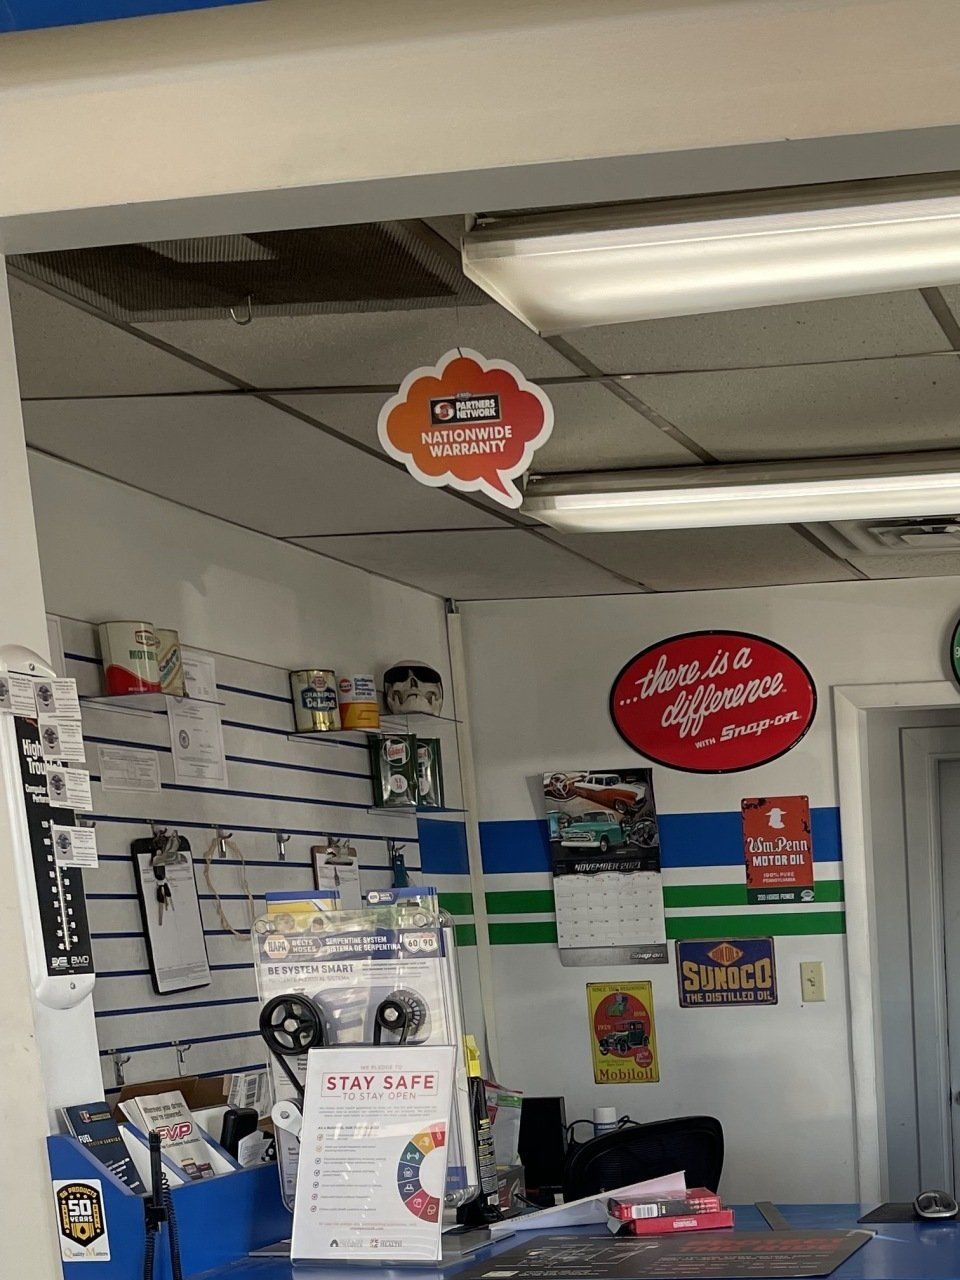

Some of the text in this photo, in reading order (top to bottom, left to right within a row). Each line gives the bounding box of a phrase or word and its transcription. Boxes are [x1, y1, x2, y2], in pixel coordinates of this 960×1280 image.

[456, 399, 495, 410] PARTNERS
[456, 408, 496, 419] NETWORK
[421, 425, 512, 444] NATIONWIDE
[430, 440, 506, 457] WARRANTY
[955, 646, 960, 657] 9
[701, 649, 729, 680] is
[733, 647, 752, 669] a
[661, 672, 784, 738] difference
[695, 710, 799, 749] WITH Snap-on
[753, 854, 805, 866] MOTOR OIL
[574, 862, 641, 871] NOVEMBER 2021
[267, 940, 287, 953] NAPA
[326, 937, 361, 945] SERPENTINE
[408, 940, 417, 948] 60
[422, 939, 433, 947] 90
[327, 945, 353, 953] SISTEMA
[363, 944, 401, 952] SERPENTINA
[268, 966, 279, 975] BE
[282, 965, 319, 975] SYSTEM
[322, 964, 354, 973] SMART
[682, 958, 772, 990] SUNOCO
[685, 991, 773, 1002] THE DISTILLED OIL
[599, 1068, 653, 1080] Mobiloil
[326, 1075, 434, 1090] STAY SAFE
[342, 1091, 416, 1101] TO STAY OPEN
[78, 1134, 93, 1143] FUEL
[68, 1186, 97, 1198] PRODUCTS
[68, 1199, 92, 1216] 50
[64, 1248, 84, 1258] Quality
